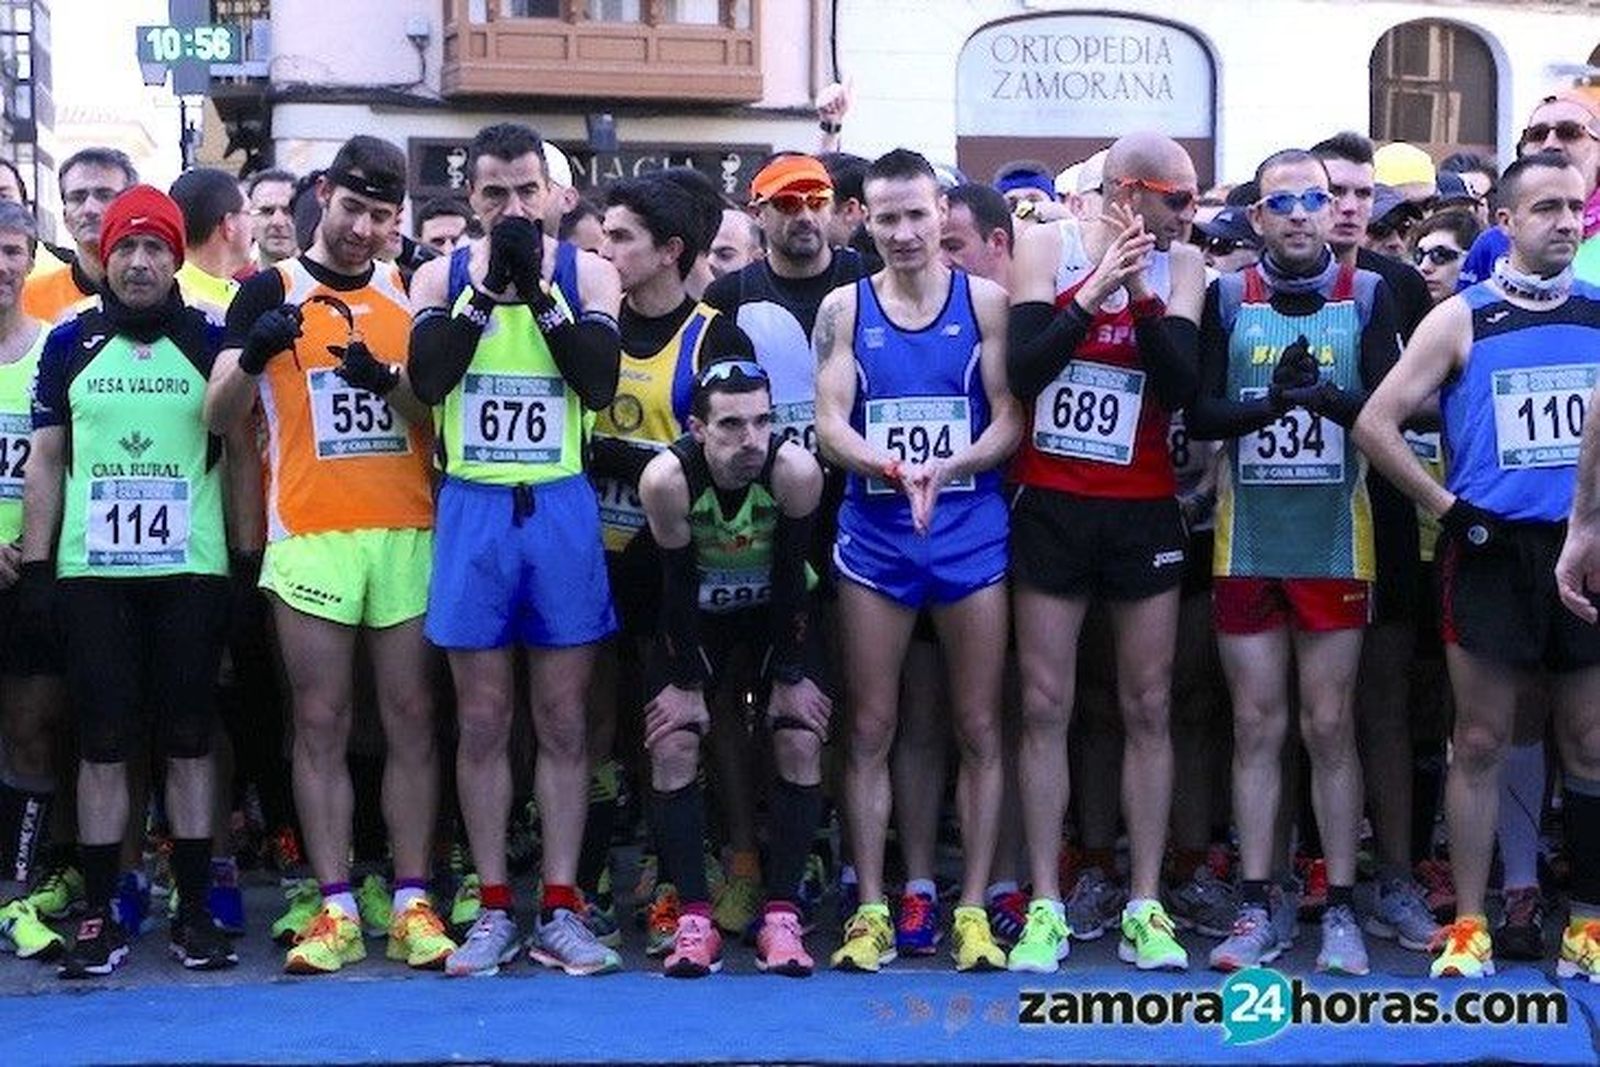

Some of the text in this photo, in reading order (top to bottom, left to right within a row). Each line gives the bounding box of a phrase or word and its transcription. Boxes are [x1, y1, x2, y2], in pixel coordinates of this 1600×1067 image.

[992, 34, 1173, 65] ORTOPEDIA
[992, 70, 1174, 101] ZAMORANA
[87, 378, 190, 395] MESA VALORIO
[332, 392, 393, 434] 553
[480, 399, 547, 444] 676
[1053, 387, 1119, 437] 689
[1518, 393, 1584, 441] 110
[887, 424, 954, 465] 594
[1257, 413, 1325, 459] 534
[130, 463, 184, 478] RURAL
[105, 503, 170, 545] 114
